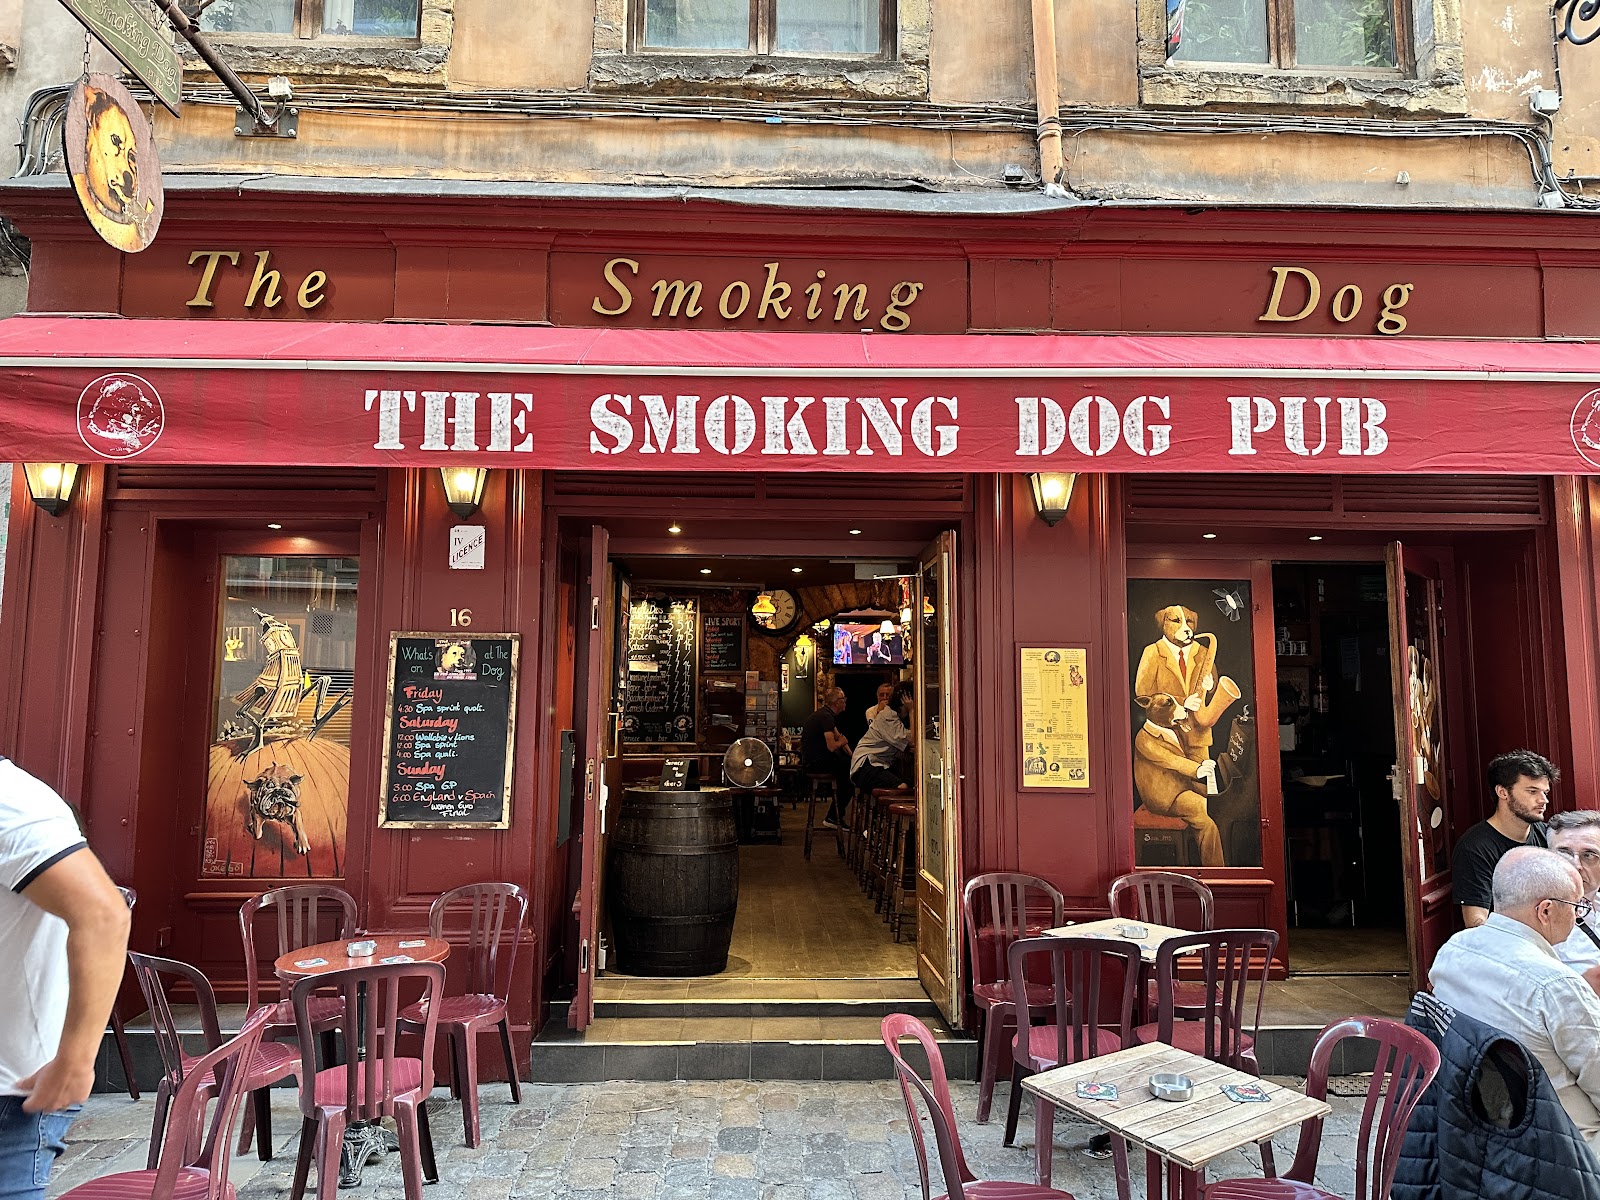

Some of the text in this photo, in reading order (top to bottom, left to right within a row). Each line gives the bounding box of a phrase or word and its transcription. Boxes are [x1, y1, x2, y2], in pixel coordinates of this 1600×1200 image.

[151, 41, 177, 93] Dog
[186, 250, 1415, 336] The Smoking Dog
[364, 389, 1389, 457] THE SMOKING DOG PUB
[452, 534, 483, 563] LICENCE
[454, 537, 463, 546] IV
[450, 608, 472, 627] 16
[704, 617, 720, 626] LIVE
[722, 617, 741, 626] SPORT
[402, 646, 434, 661] What's
[484, 645, 509, 660] at The
[410, 664, 423, 673] on
[482, 663, 505, 681] Dog
[403, 685, 443, 704] Friday
[416, 703, 433, 714] Spa
[437, 702, 460, 713] sprint
[400, 716, 458, 733] Saturday
[415, 741, 431, 750] Spa
[435, 741, 458, 749] sprint
[414, 751, 431, 760] Spa
[397, 761, 446, 781] Sunday
[415, 782, 435, 792] Spa
[465, 790, 496, 803] Spain
